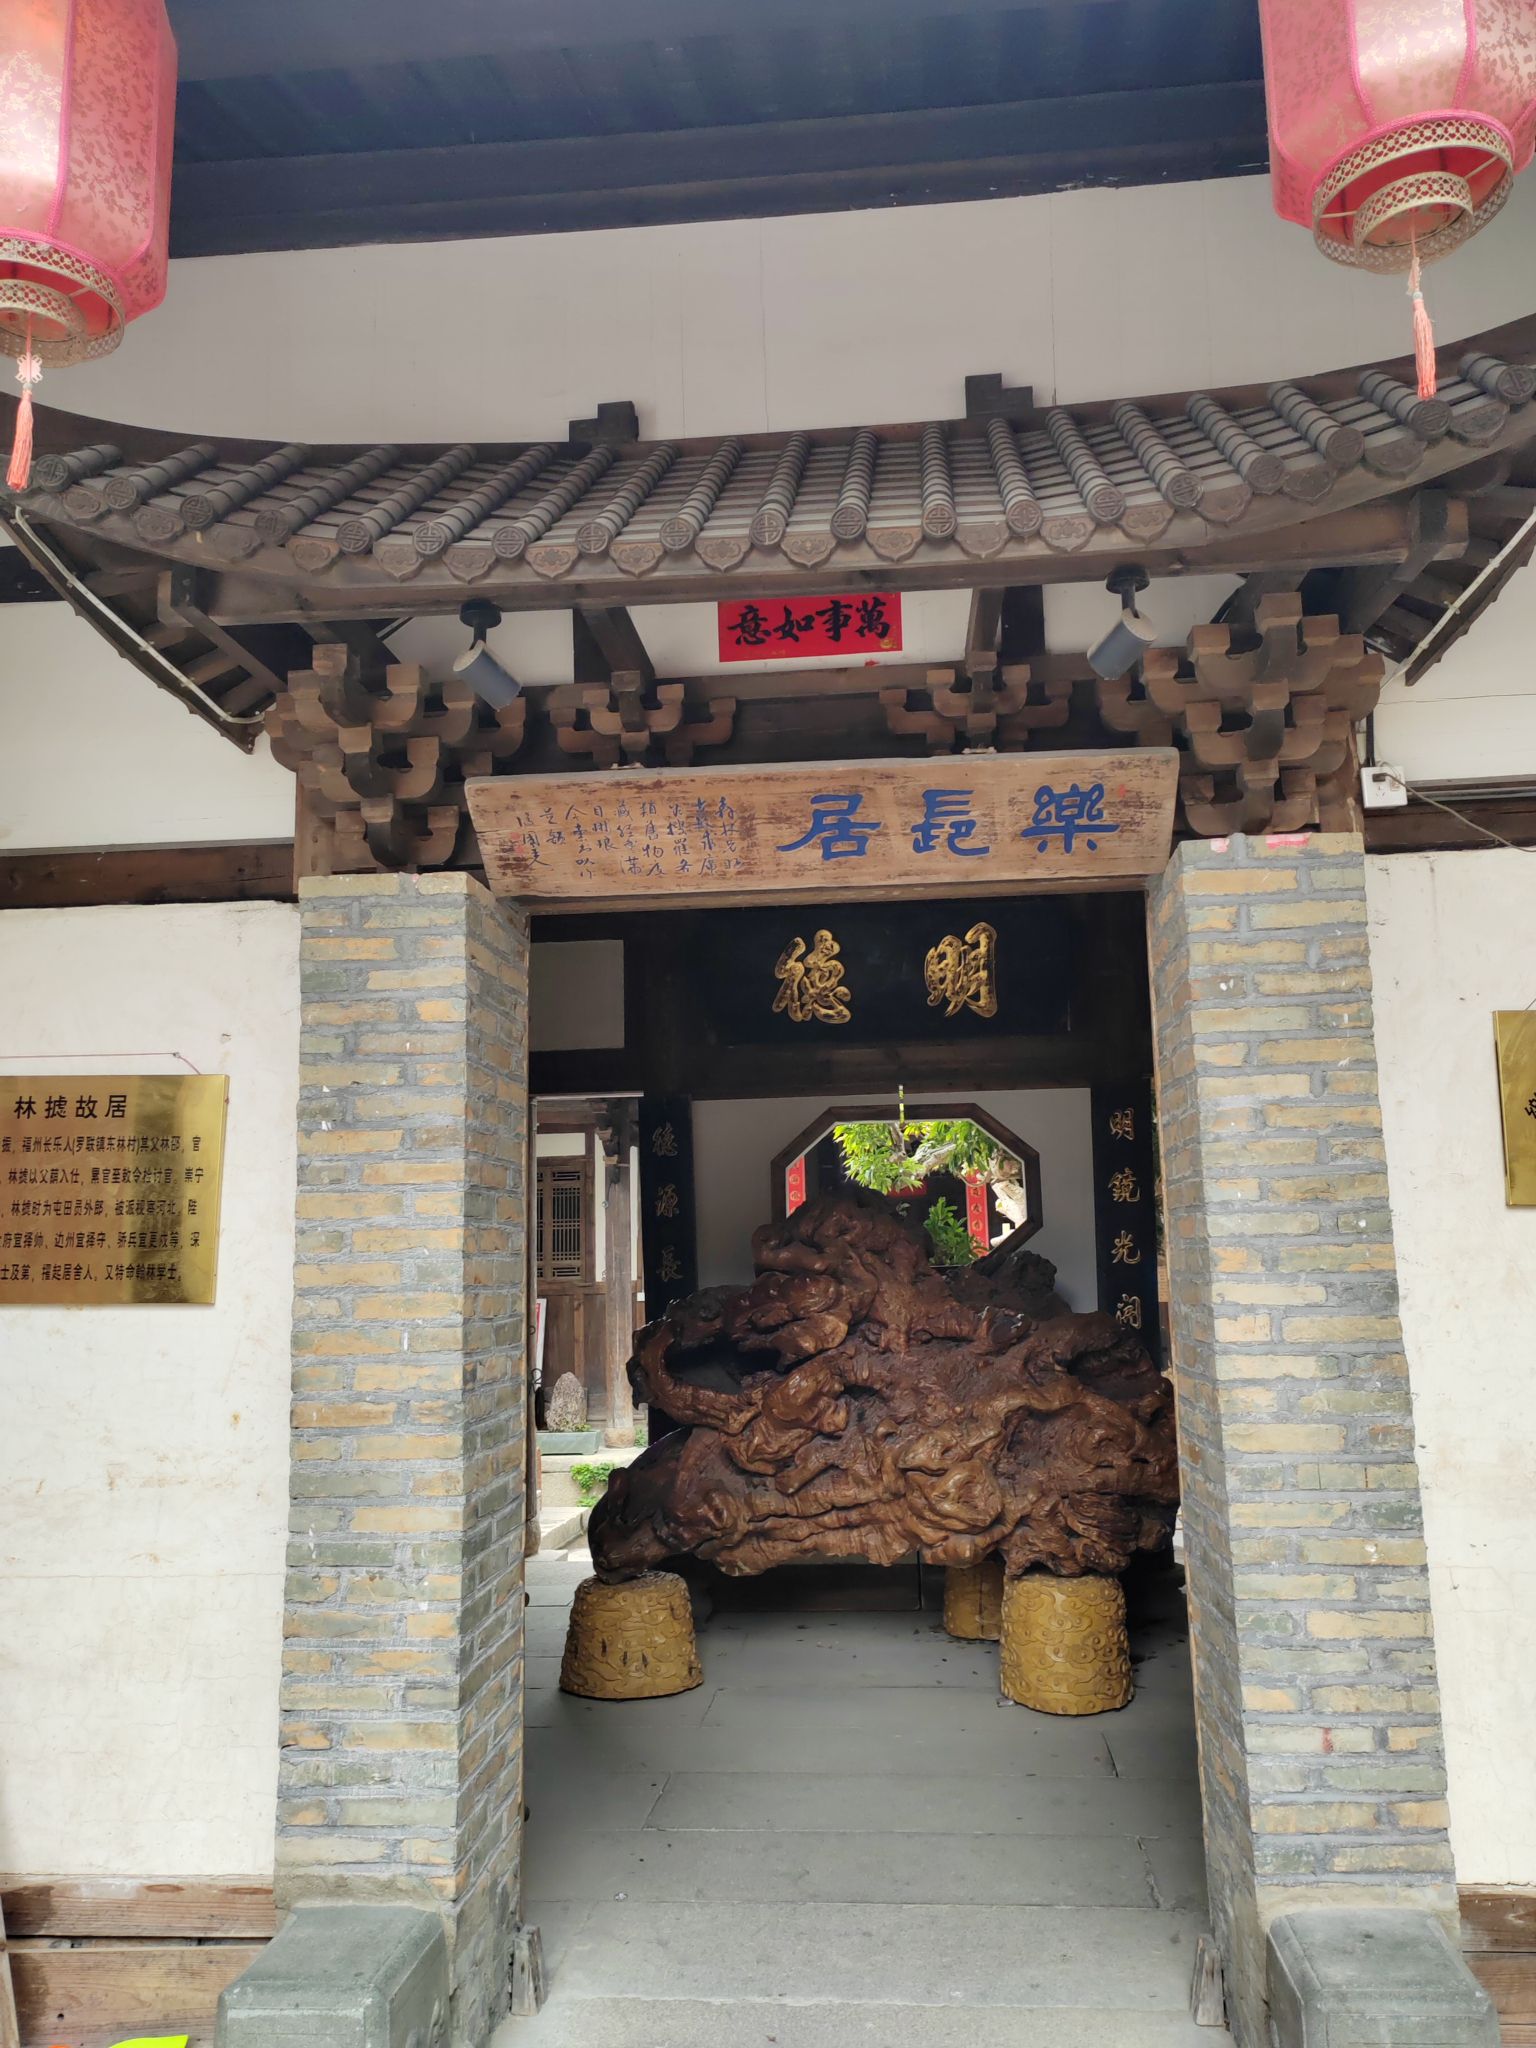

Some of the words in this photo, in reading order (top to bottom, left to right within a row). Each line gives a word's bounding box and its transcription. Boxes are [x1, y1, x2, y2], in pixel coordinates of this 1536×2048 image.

[727, 596, 891, 646] 萬事如意
[14, 1094, 127, 1119] 林摅故居
